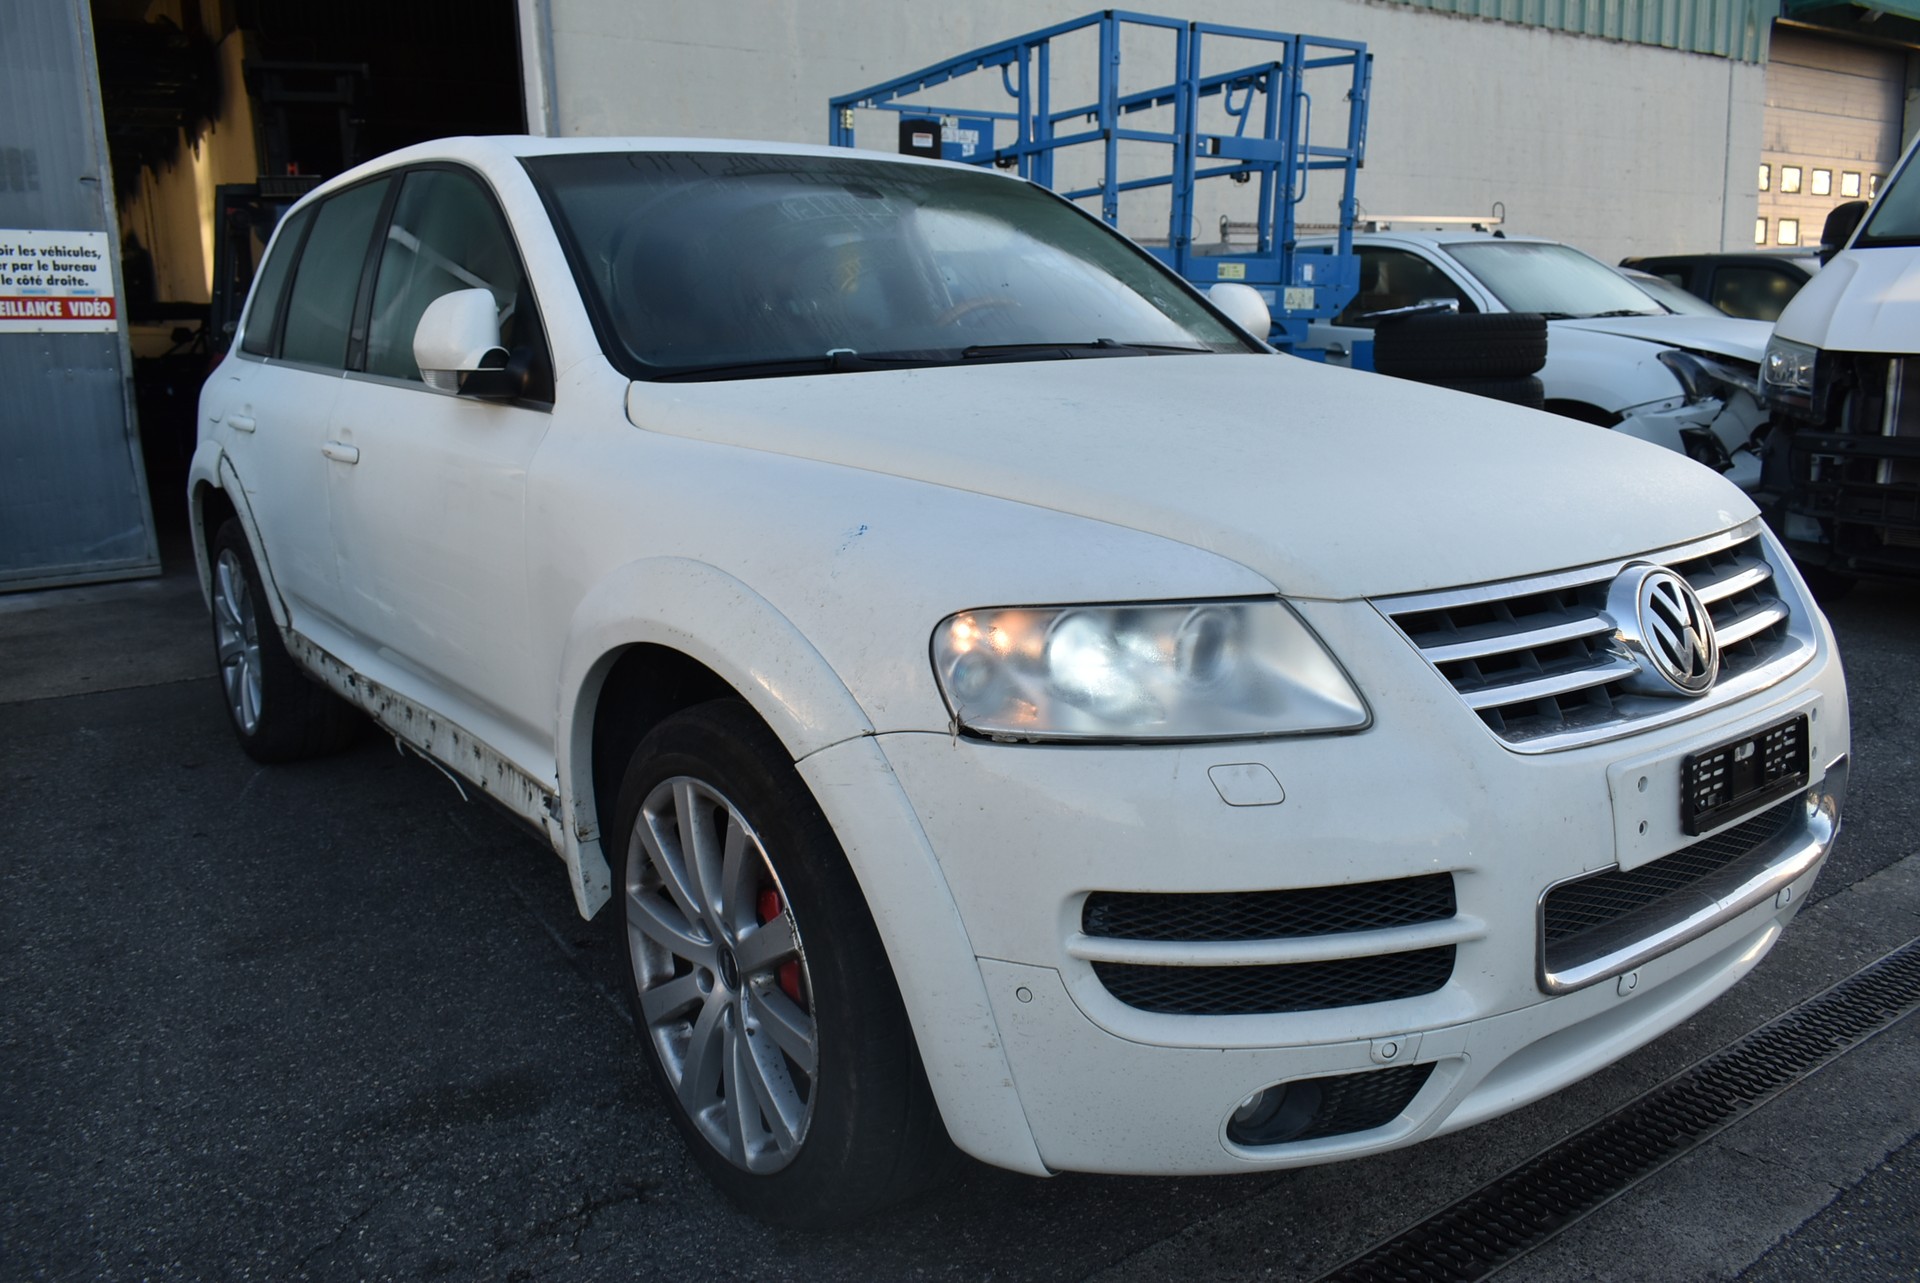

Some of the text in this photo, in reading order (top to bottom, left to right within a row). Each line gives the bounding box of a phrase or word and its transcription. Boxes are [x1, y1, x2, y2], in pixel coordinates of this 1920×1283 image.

[18, 245, 36, 256] les
[40, 246, 101, 259] véhicules,
[12, 262, 33, 273] par
[37, 260, 49, 271] le
[53, 260, 97, 272] bureau
[1, 274, 89, 286] le côté droite.
[0, 298, 111, 317] EILLANCE VIDÉO
